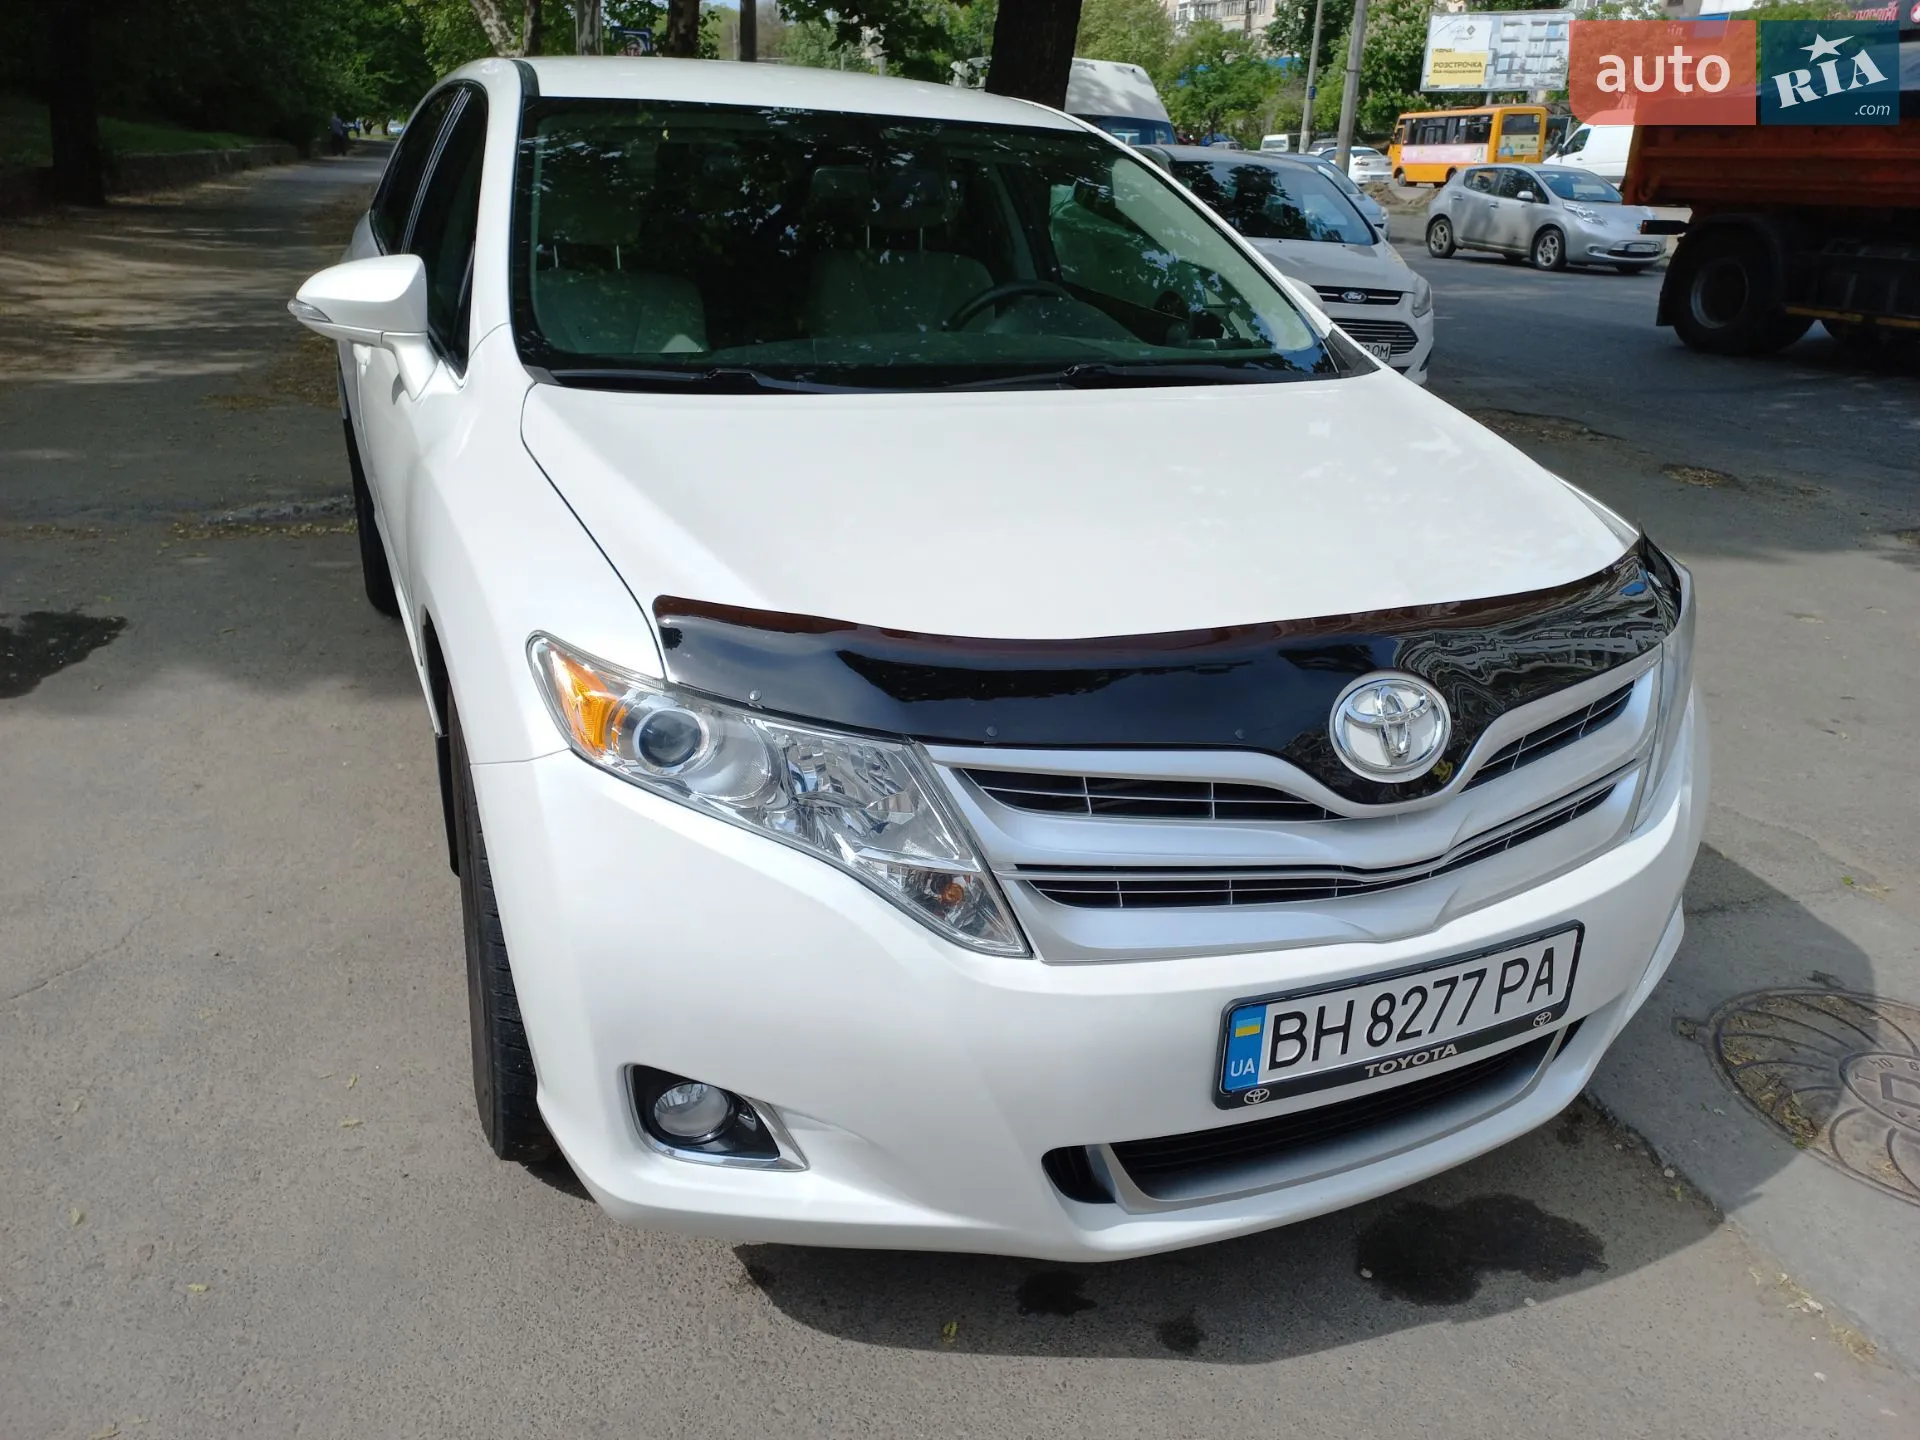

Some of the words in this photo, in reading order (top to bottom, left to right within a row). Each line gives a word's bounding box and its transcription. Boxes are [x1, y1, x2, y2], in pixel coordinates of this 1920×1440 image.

[1268, 1000, 1355, 1070] BH
[1366, 968, 1487, 1047] 8277
[1494, 947, 1554, 1014] PA
[1230, 1060, 1255, 1077] UA
[1364, 1043, 1458, 1079] TOYOTA
